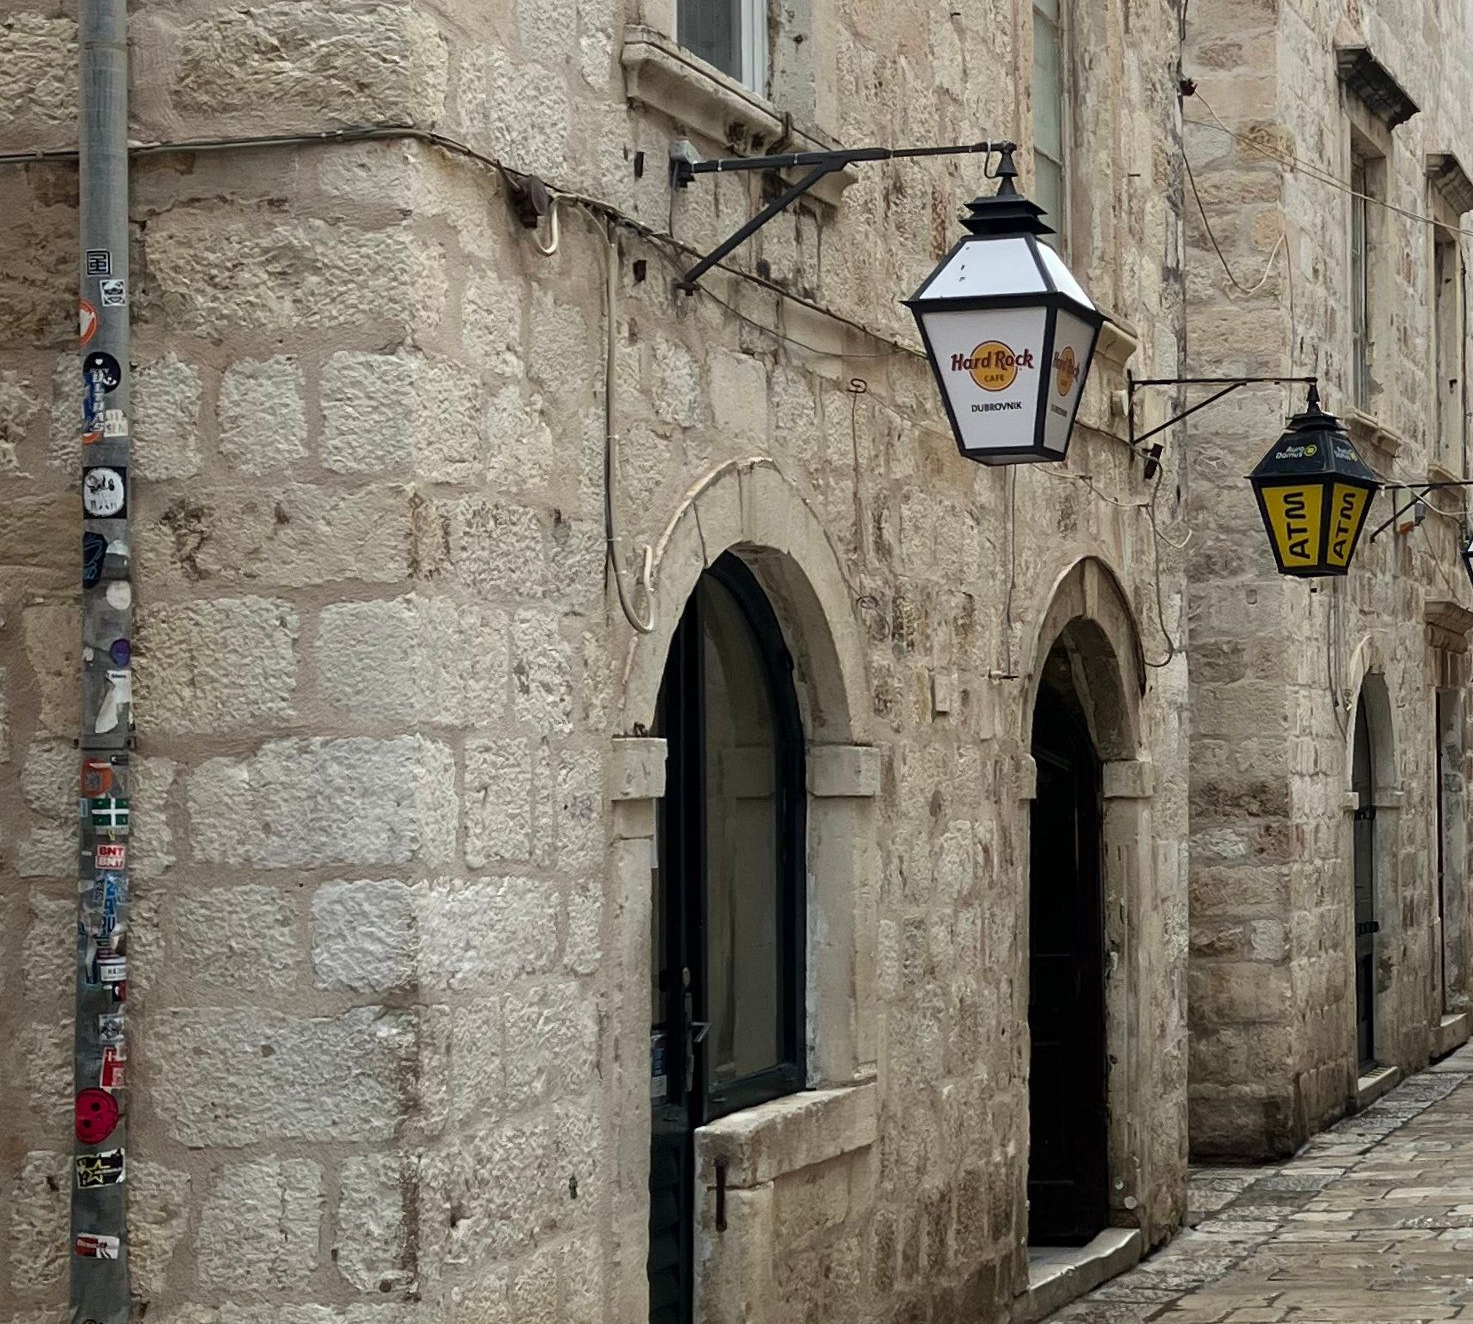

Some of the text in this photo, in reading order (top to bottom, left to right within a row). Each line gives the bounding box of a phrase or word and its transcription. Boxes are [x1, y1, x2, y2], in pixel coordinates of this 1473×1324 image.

[951, 351, 993, 371] Hard
[994, 348, 1034, 371] Rock
[984, 374, 1005, 382] CAFE
[971, 402, 1022, 413] DUBROVNIK
[1283, 492, 1311, 559] ATM
[1333, 493, 1356, 560] ATM
